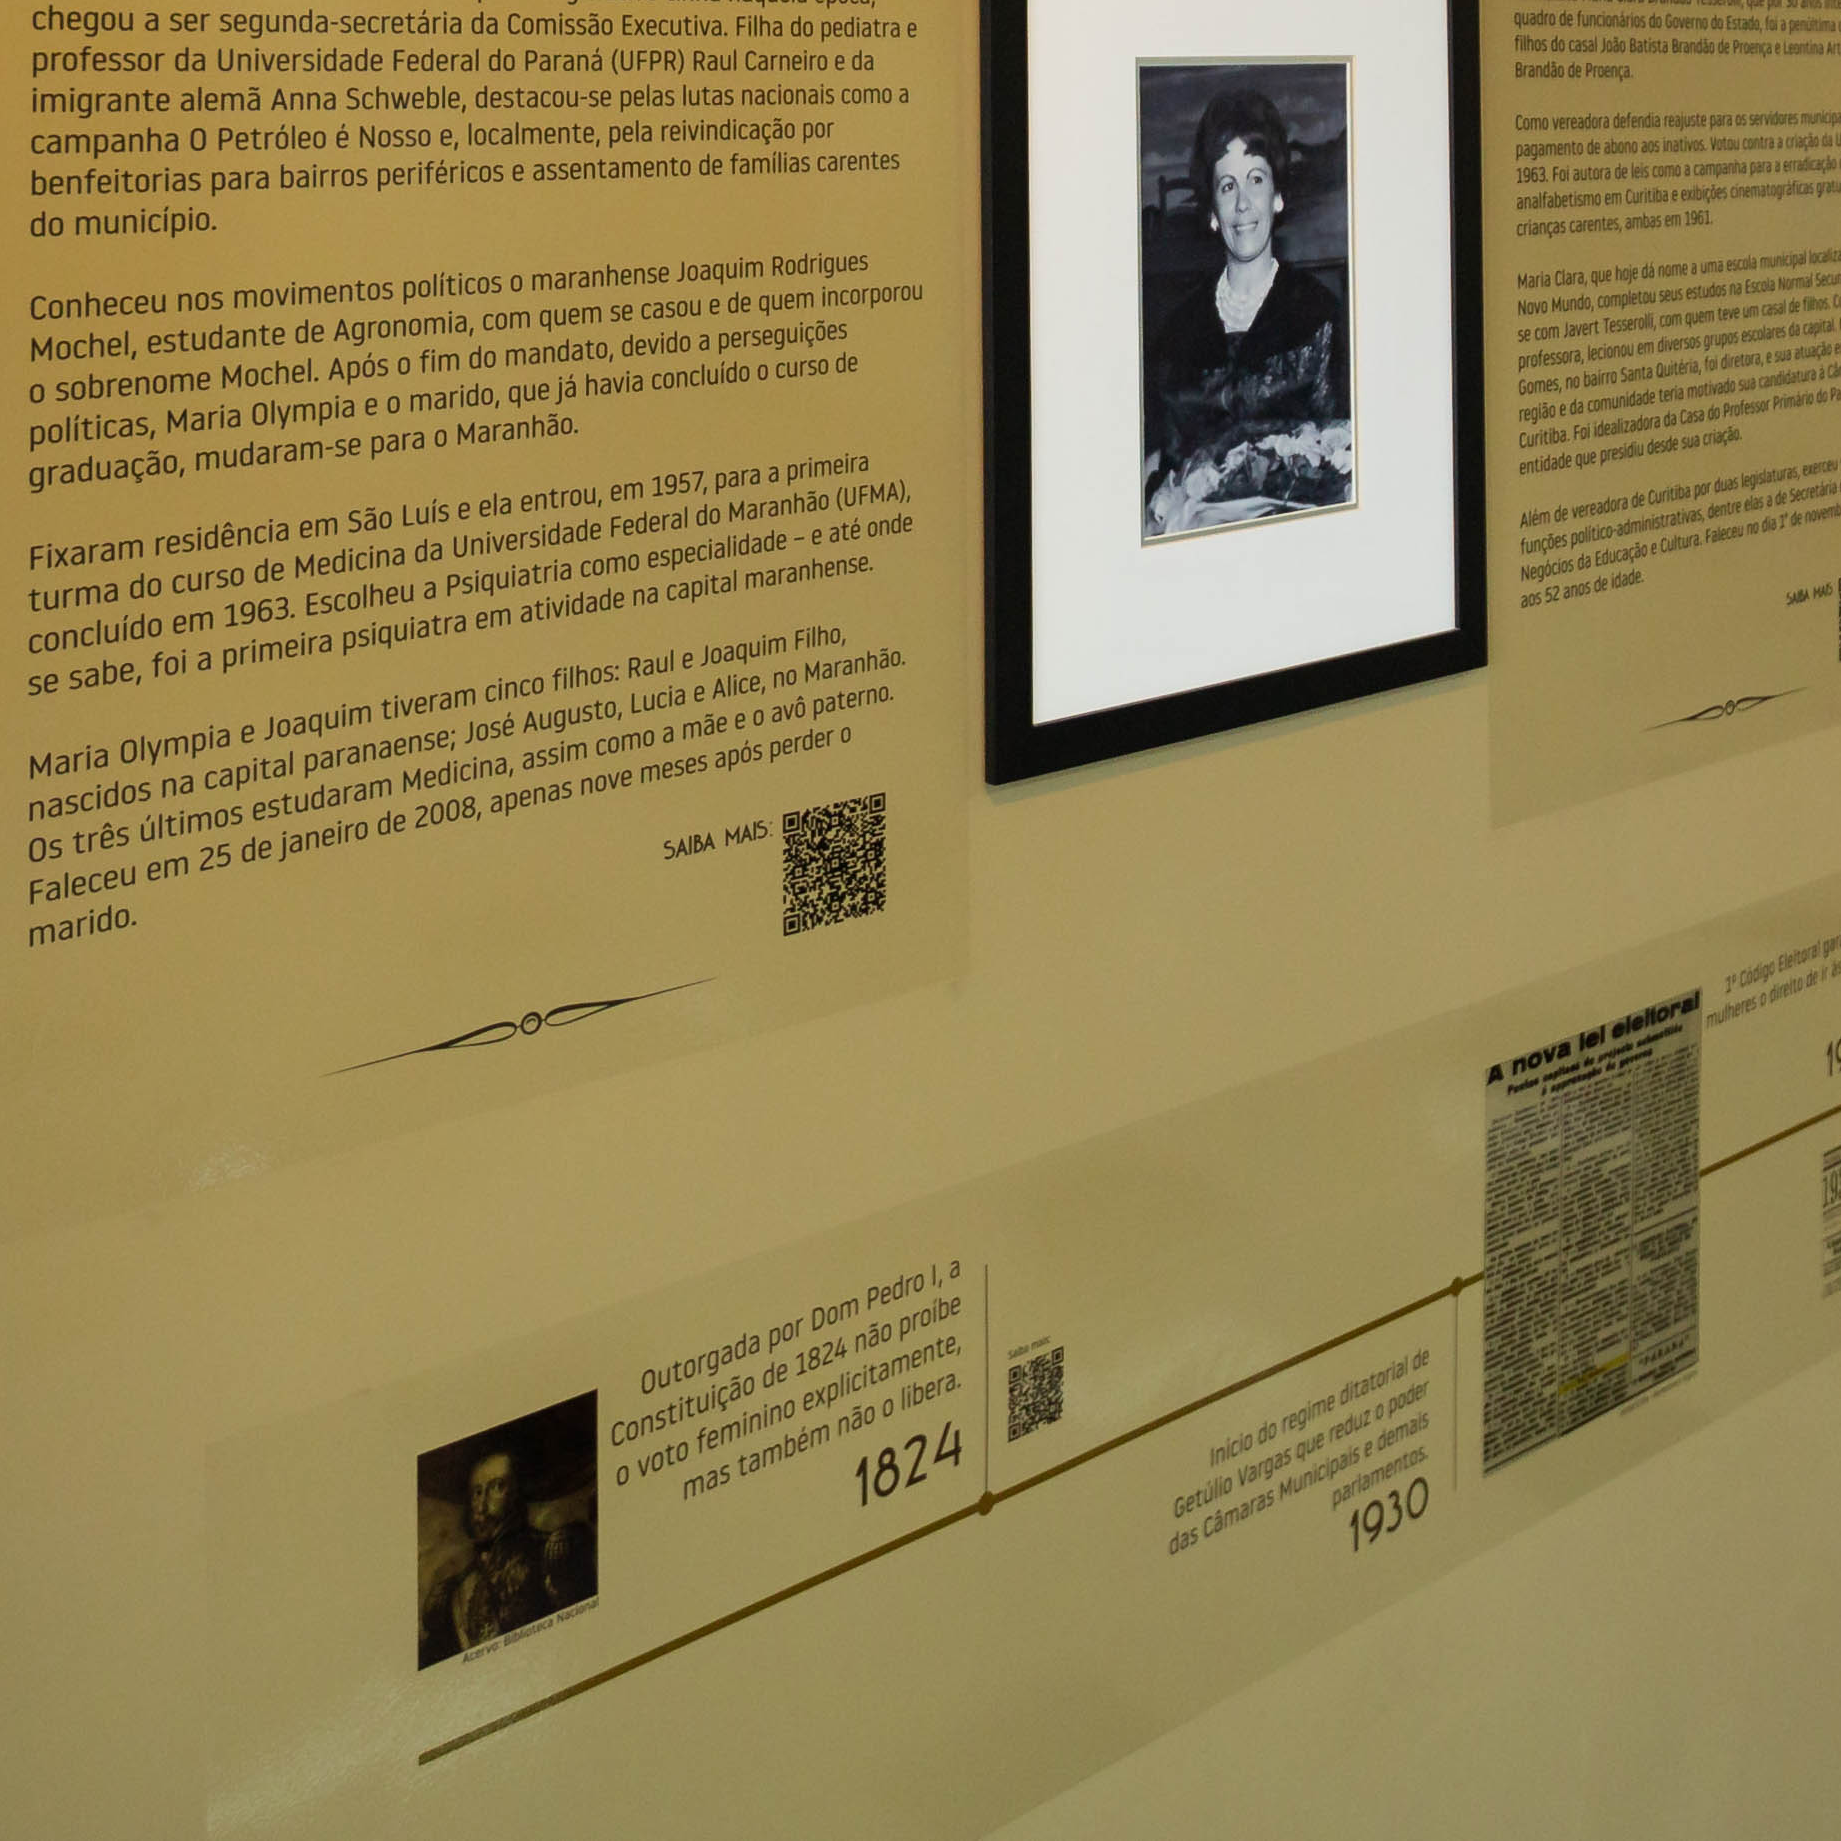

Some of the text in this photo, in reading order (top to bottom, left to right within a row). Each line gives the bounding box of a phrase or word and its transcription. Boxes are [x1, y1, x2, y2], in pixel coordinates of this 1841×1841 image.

[1516, 162, 1550, 184] 1963.
[1552, 163, 1570, 183] Foi
[1573, 166, 1611, 183] autora
[1613, 163, 1628, 182] de
[1631, 162, 1650, 180] leis
[1651, 161, 1681, 181] como
[1683, 163, 1691, 177] a
[1693, 159, 1747, 179] campanha
[1749, 161, 1772, 178] para
[1774, 159, 1781, 175] a
[1783, 155, 1837, 177] erradicação
[1516, 209, 1713, 239] crianças carentes, ambas em 1961.
[1520, 567, 1645, 609] aos 52 anos de idade.
[663, 831, 716, 860] SAIBA
[1706, 996, 1757, 1029] mulheres
[1760, 992, 1767, 1007] o
[1770, 977, 1803, 1004] direito
[1806, 969, 1818, 988] de
[1821, 965, 1828, 981] ir
[1740, 964, 1775, 987] Código
[1778, 940, 1821, 972] Eleitoral
[1487, 1064, 1504, 1086] A
[1512, 1040, 1571, 1075] nova
[641, 1333, 760, 1395] Outorgada
[769, 1317, 804, 1355] por
[811, 1298, 859, 1332] Dom
[867, 1273, 925, 1311] Pedro
[949, 1260, 960, 1279] a
[611, 1296, 961, 1447] Constituição de 1824 não proíbe
[616, 1336, 961, 1487] o voto feminino explicitamente,
[683, 1373, 961, 1501] mas também não o libera.
[1209, 1348, 1430, 1468] Início do regime ditatorial de
[855, 1420, 963, 1507] 1824
[1168, 1411, 1429, 1556] das Câmaras Municipais e demais
[1173, 1380, 1430, 1519] Getúlio Vargas que reduz o poder
[1331, 1445, 1429, 1511] parlamentos.
[1349, 1476, 1429, 1553] 1930
[503, 1619, 553, 1647] Biblioteca
[557, 1597, 599, 1623] Nacional
